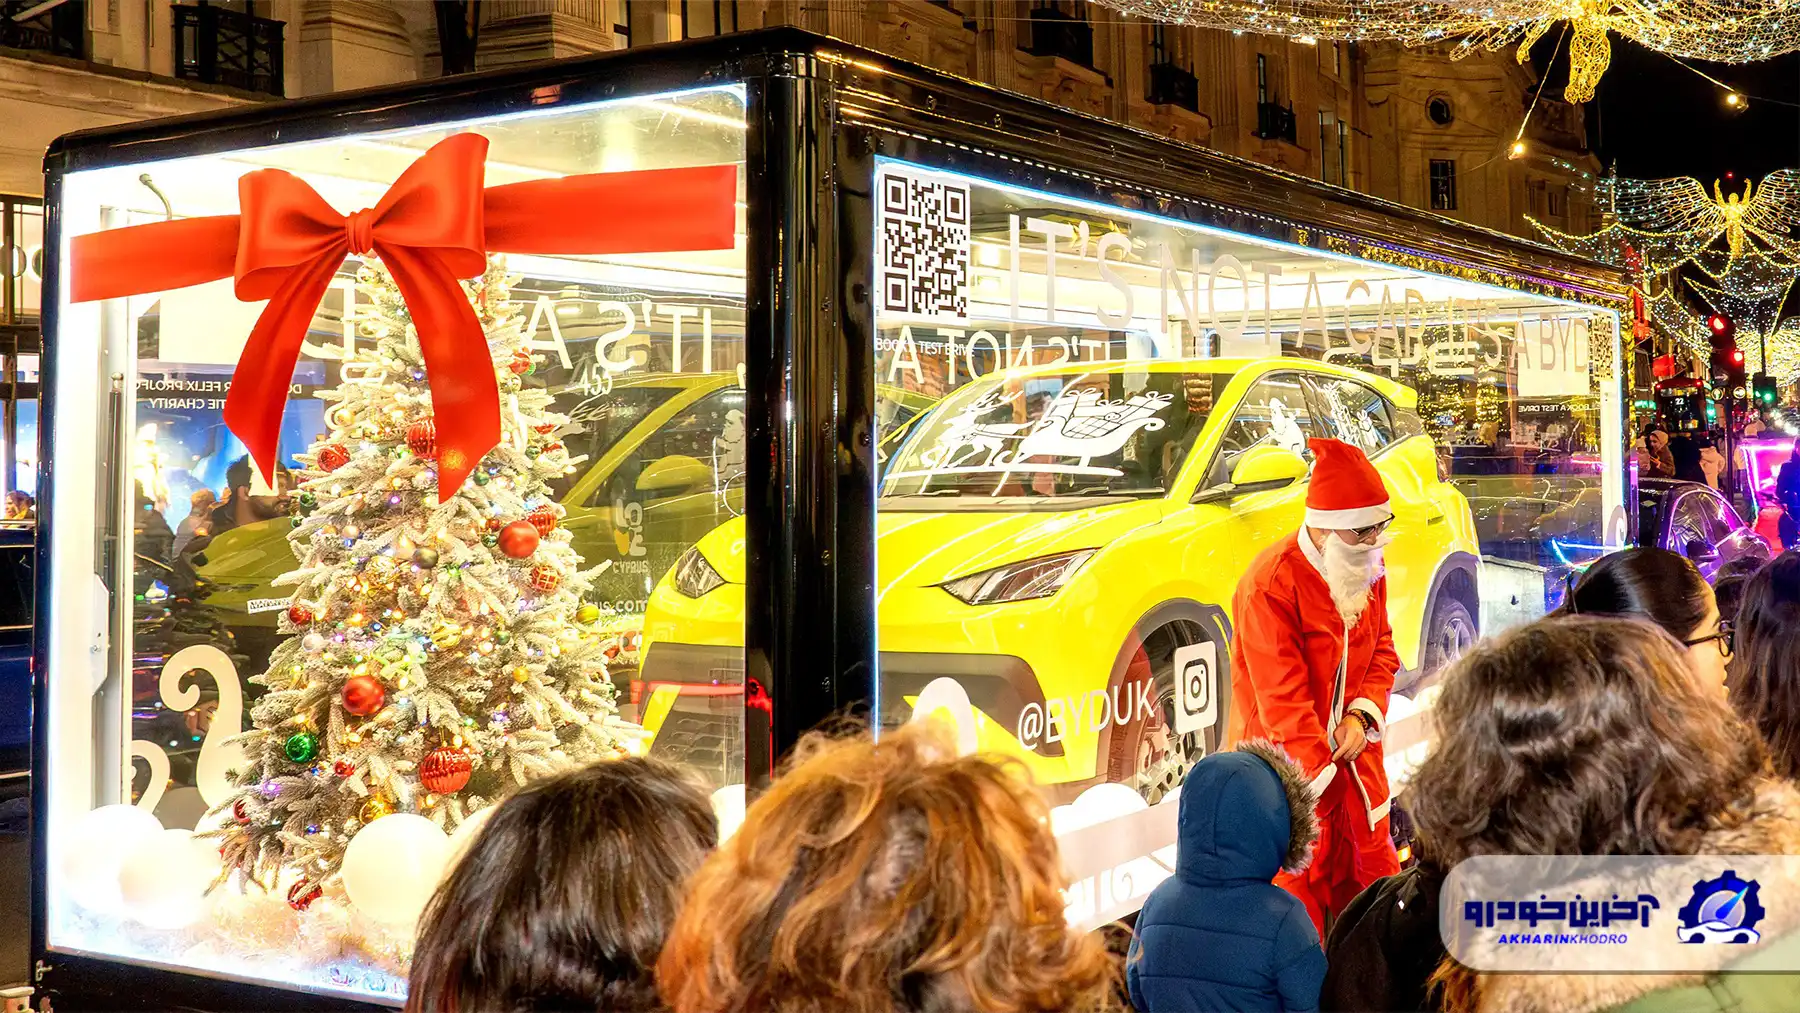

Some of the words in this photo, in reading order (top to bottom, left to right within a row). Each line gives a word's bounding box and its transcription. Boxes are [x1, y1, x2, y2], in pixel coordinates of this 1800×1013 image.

[1009, 213, 1135, 330] IT'S
[1160, 242, 1282, 346] NOT
[1296, 270, 1331, 350] A
[1343, 278, 1427, 359] CAR
[1539, 311, 1588, 373] BYD
[1017, 677, 1155, 750] @BYDUK
